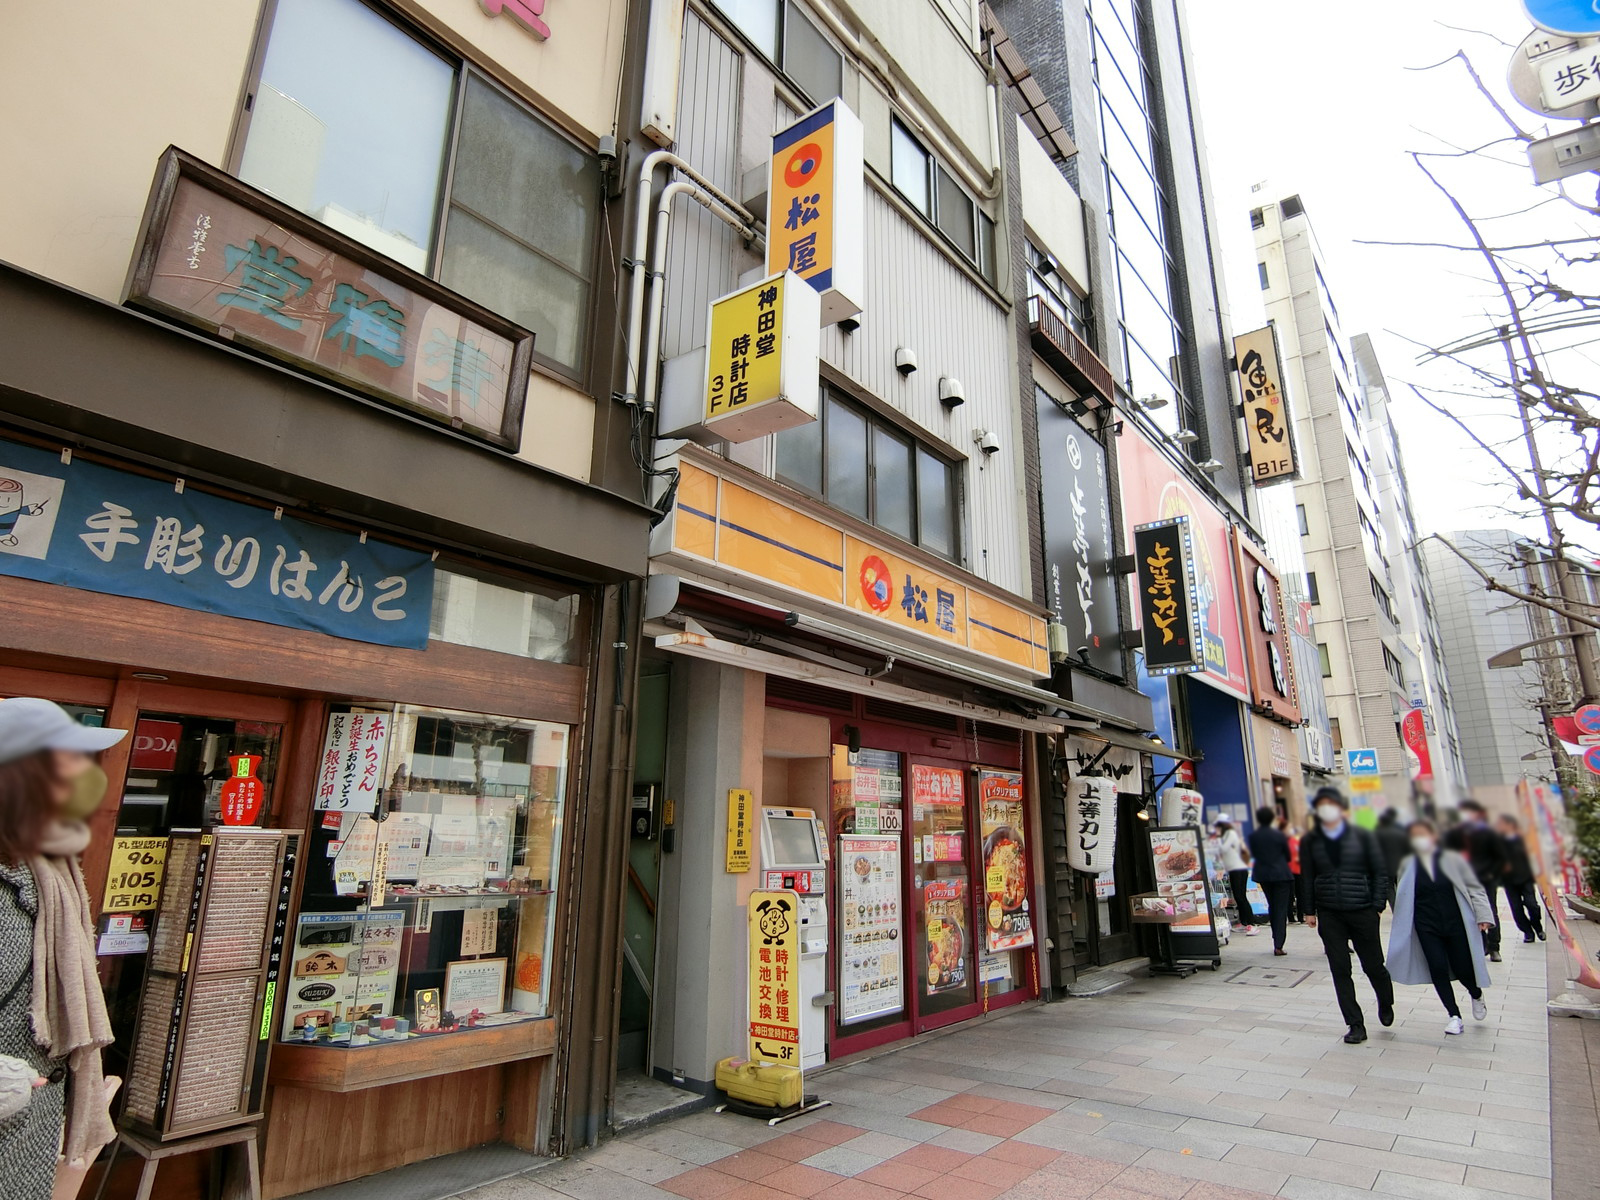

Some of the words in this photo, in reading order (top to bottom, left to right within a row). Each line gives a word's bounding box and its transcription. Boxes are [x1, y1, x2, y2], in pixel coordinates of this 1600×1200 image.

[784, 193, 820, 272] 松屋
[756, 285, 777, 359] 神田堂
[711, 375, 724, 413] 3F
[728, 333, 751, 407] 時計店
[1241, 350, 1284, 444] 魚民
[1257, 459, 1289, 476] B1F
[79, 501, 408, 622] 手彫りはんこ
[900, 573, 956, 634] 松屋
[320, 715, 345, 809] 記念に銀行印は
[340, 715, 364, 808] お誕生おめでとう
[358, 716, 385, 792] 赤ちゃん
[856, 775, 877, 789] お弁当
[930, 771, 962, 796] お弁当
[737, 794, 745, 847] 神田堂時計店
[857, 816, 878, 828] 生野菜
[1078, 782, 1100, 867] 上等カレー
[1182, 804, 1199, 826] 大阪
[118, 840, 168, 849] 丸型認印
[360, 925, 396, 939] 佐々木
[305, 961, 338, 972] 鈴木
[759, 947, 772, 1021] 電池交換
[775, 948, 790, 1023] 時計・修理
[303, 989, 330, 998] SUZUKI
[754, 1026, 796, 1041] 神田堂時計店
[779, 1046, 794, 1060] 3F
